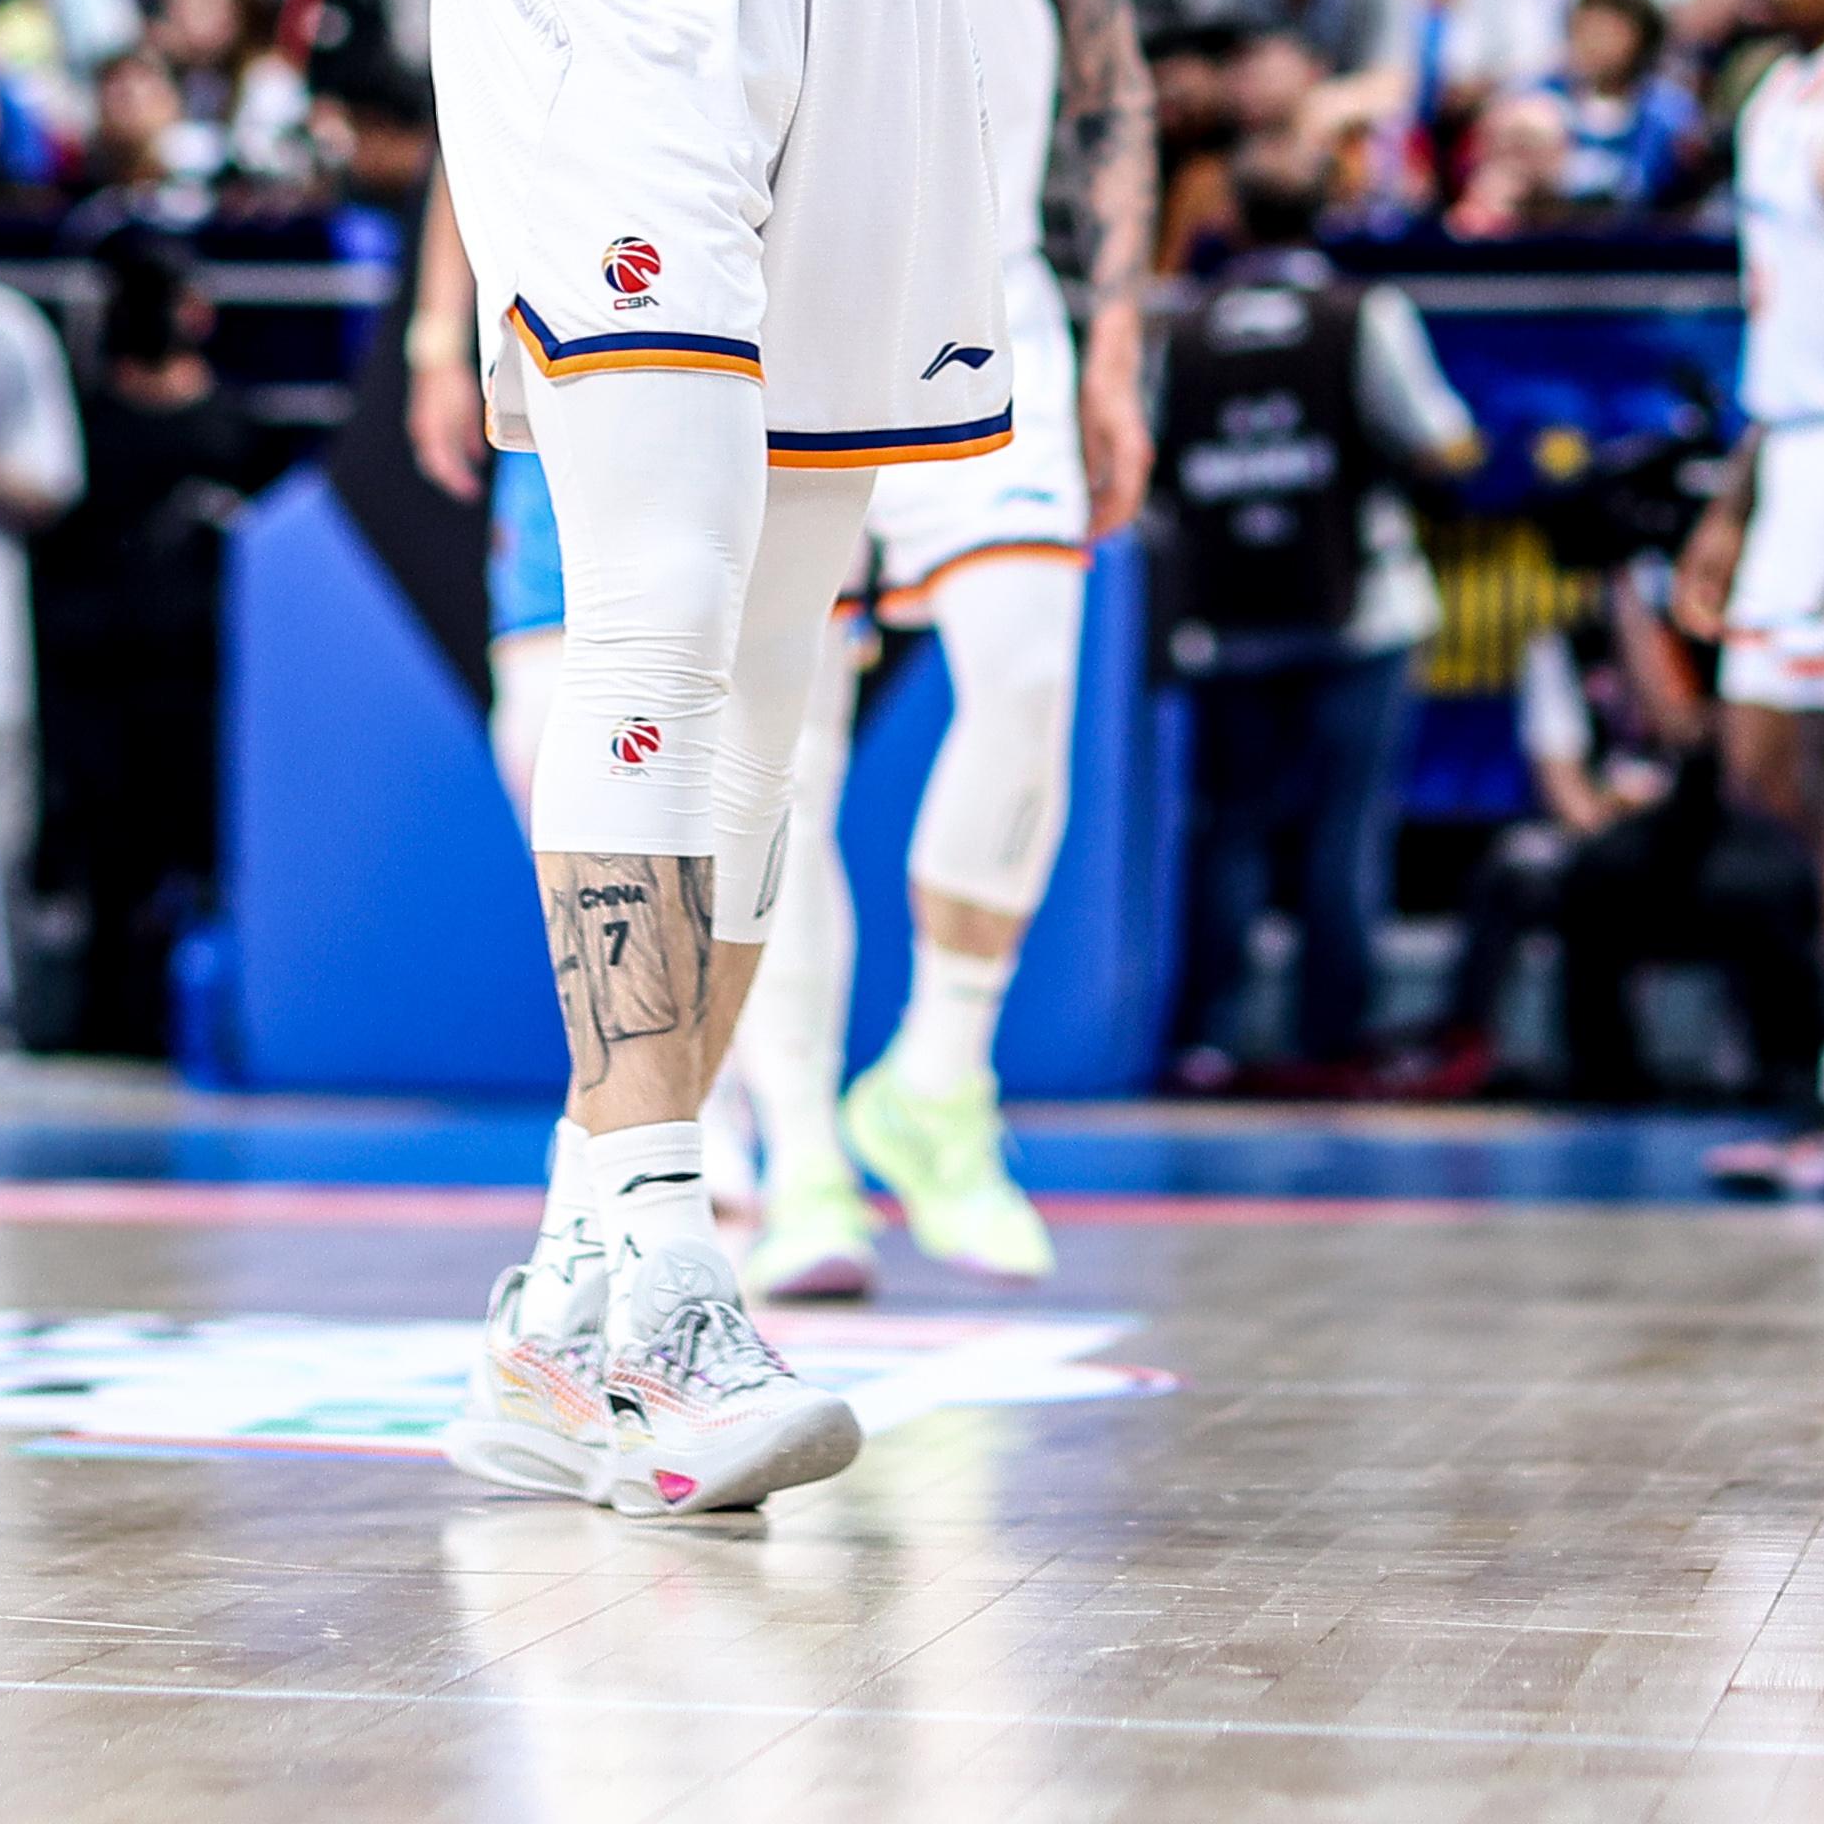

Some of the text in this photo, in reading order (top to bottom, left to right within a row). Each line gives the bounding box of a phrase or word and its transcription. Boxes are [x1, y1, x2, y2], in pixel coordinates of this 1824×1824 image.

[614, 295, 660, 310] CBA
[579, 883, 647, 910] CHINA
[603, 920, 629, 967] 7
